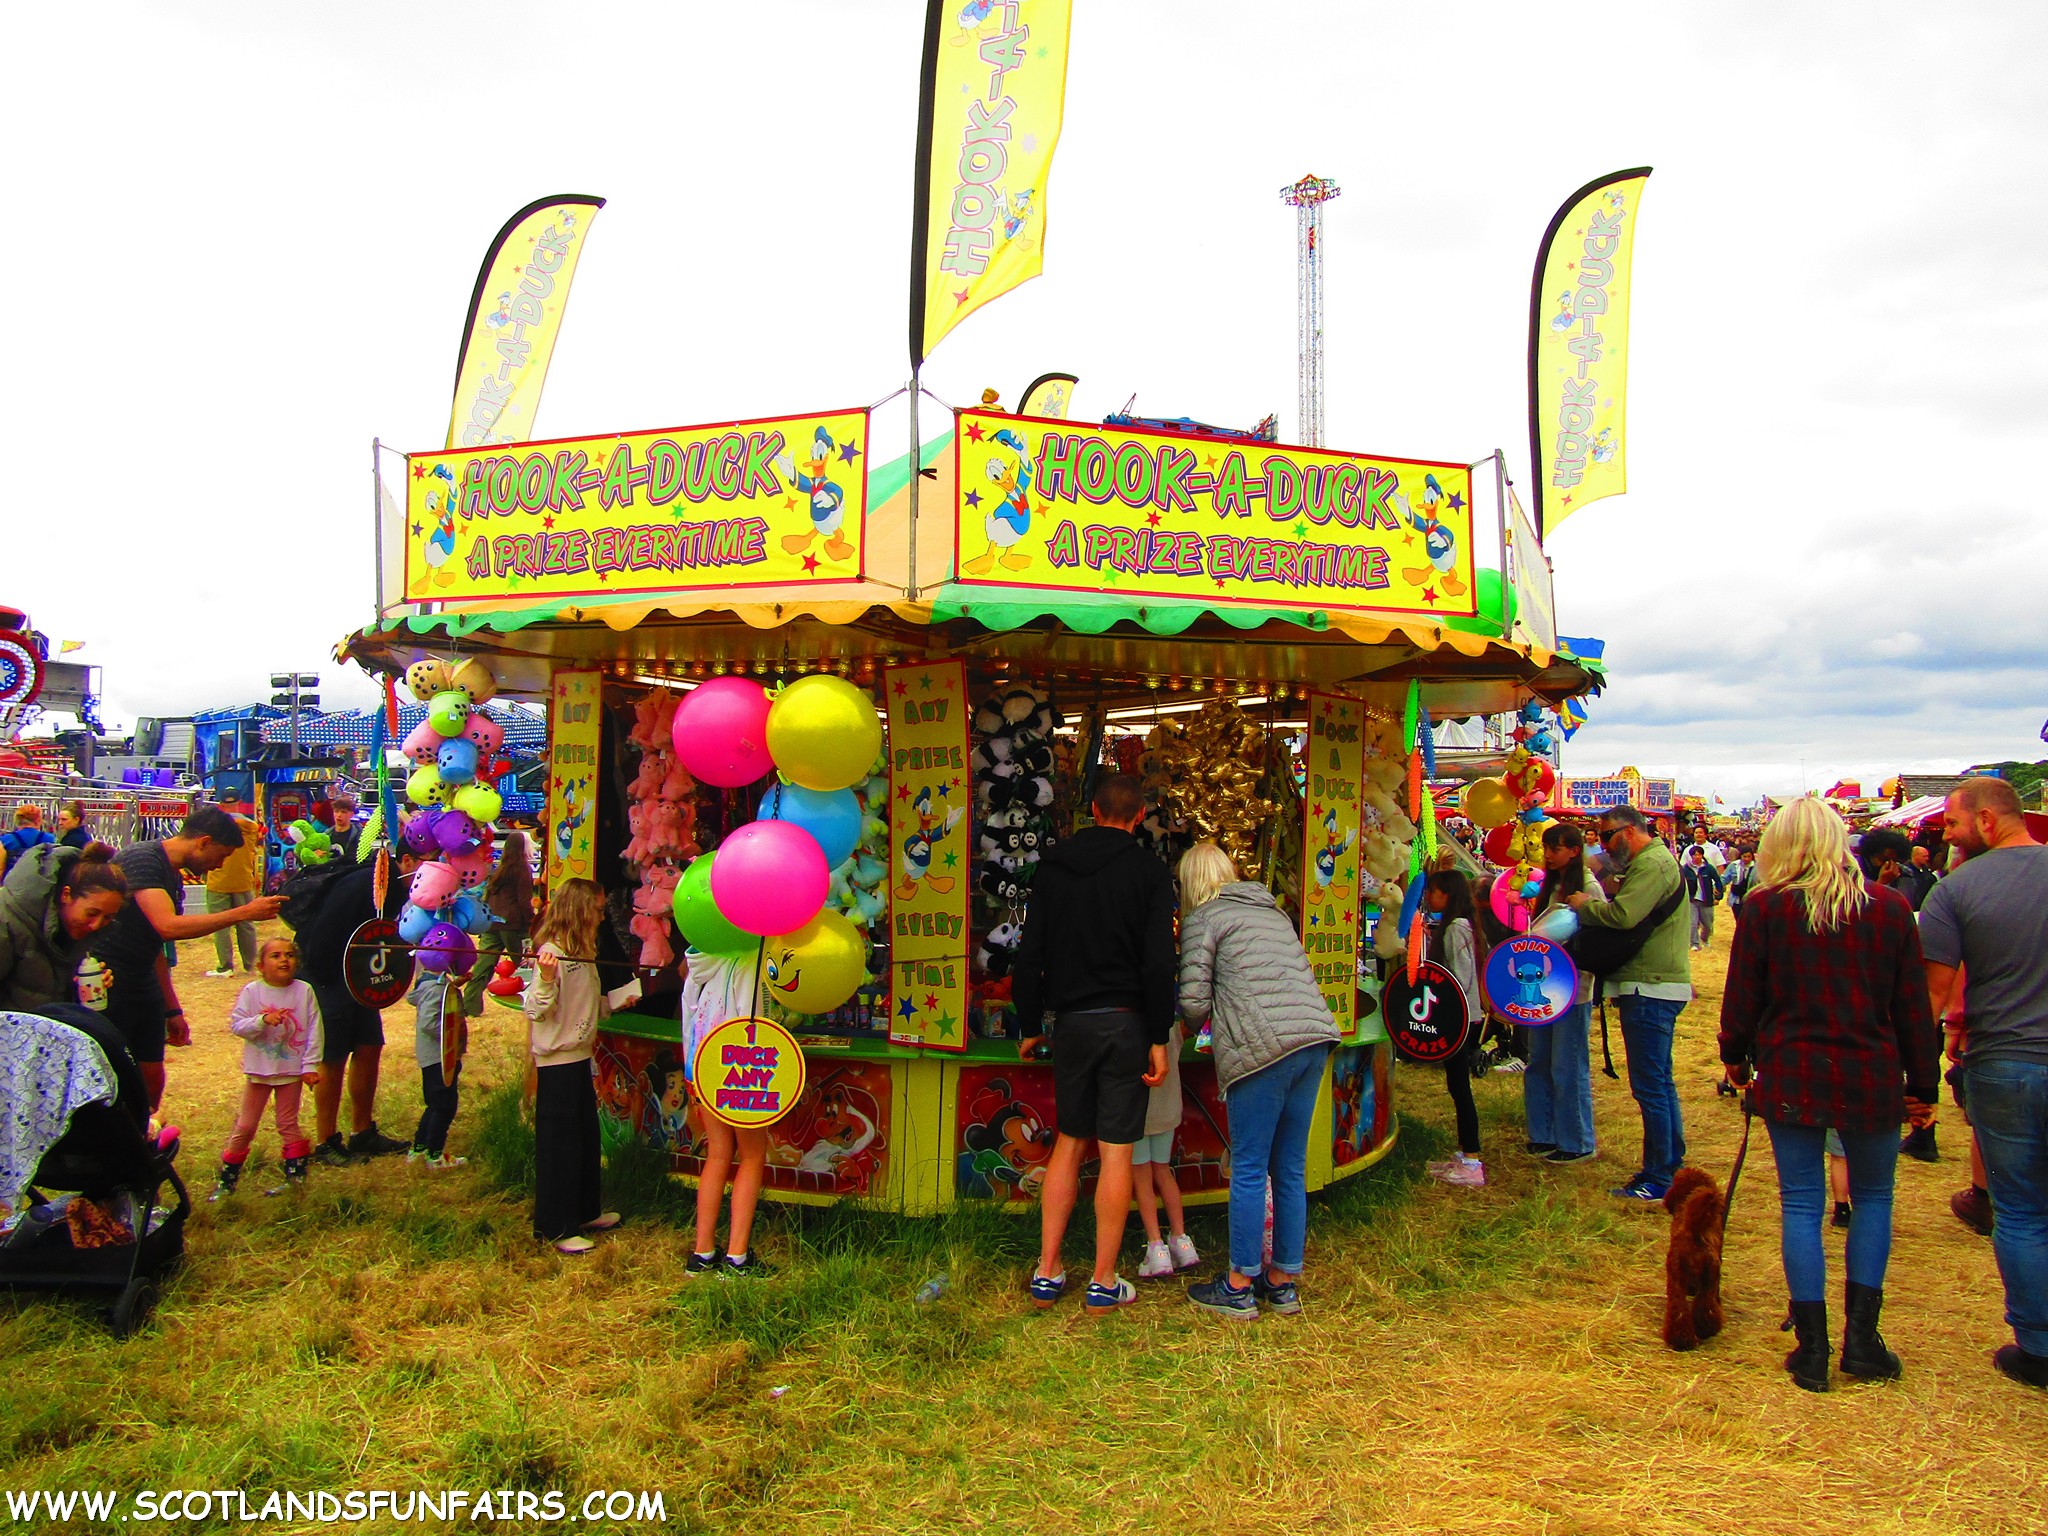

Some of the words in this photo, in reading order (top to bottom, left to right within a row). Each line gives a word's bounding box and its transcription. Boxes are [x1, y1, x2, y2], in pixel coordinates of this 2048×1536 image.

[940, 0, 1030, 277] HOOK-A-
[463, 224, 576, 447] OOK-A-DUCK
[1552, 208, 1627, 489] HOOK-A-DUCK
[459, 430, 786, 520] HOOK-A-DUCK
[1034, 432, 1402, 532] HOOK-A-DUCK
[467, 536, 491, 581] A
[494, 529, 591, 579] PRIZE
[593, 517, 770, 574] EVERYTIME
[1045, 520, 1078, 568] A
[1083, 525, 1209, 578] PRIZE
[1205, 536, 1391, 591] EVERYTIME
[562, 702, 592, 723] ANY
[903, 698, 949, 725] ANY
[1314, 715, 1359, 743] HOOK
[554, 744, 596, 766] PRIZE
[894, 745, 964, 772] PRIZE
[1329, 748, 1342, 772] A
[1313, 774, 1355, 801] DUCK
[1571, 781, 1595, 789] ONE
[1600, 781, 1628, 789] RING
[1572, 795, 1595, 806] TO
[1599, 795, 1628, 806] WIN
[895, 911, 964, 940] EVERY
[1324, 904, 1336, 927] A
[1305, 932, 1353, 956] PRIZE
[1510, 940, 1550, 954] WIN
[370, 973, 395, 985] TikTok
[901, 961, 958, 989] TIME
[1309, 961, 1353, 985] VERY
[1504, 1002, 1554, 1020] HERE
[744, 1024, 757, 1044] 1
[1408, 1021, 1438, 1035] TikTok
[1400, 1031, 1448, 1053] CRAZE
[721, 1044, 780, 1068] DUCK
[722, 1066, 775, 1090] ANY
[716, 1089, 780, 1112] PRIZE
